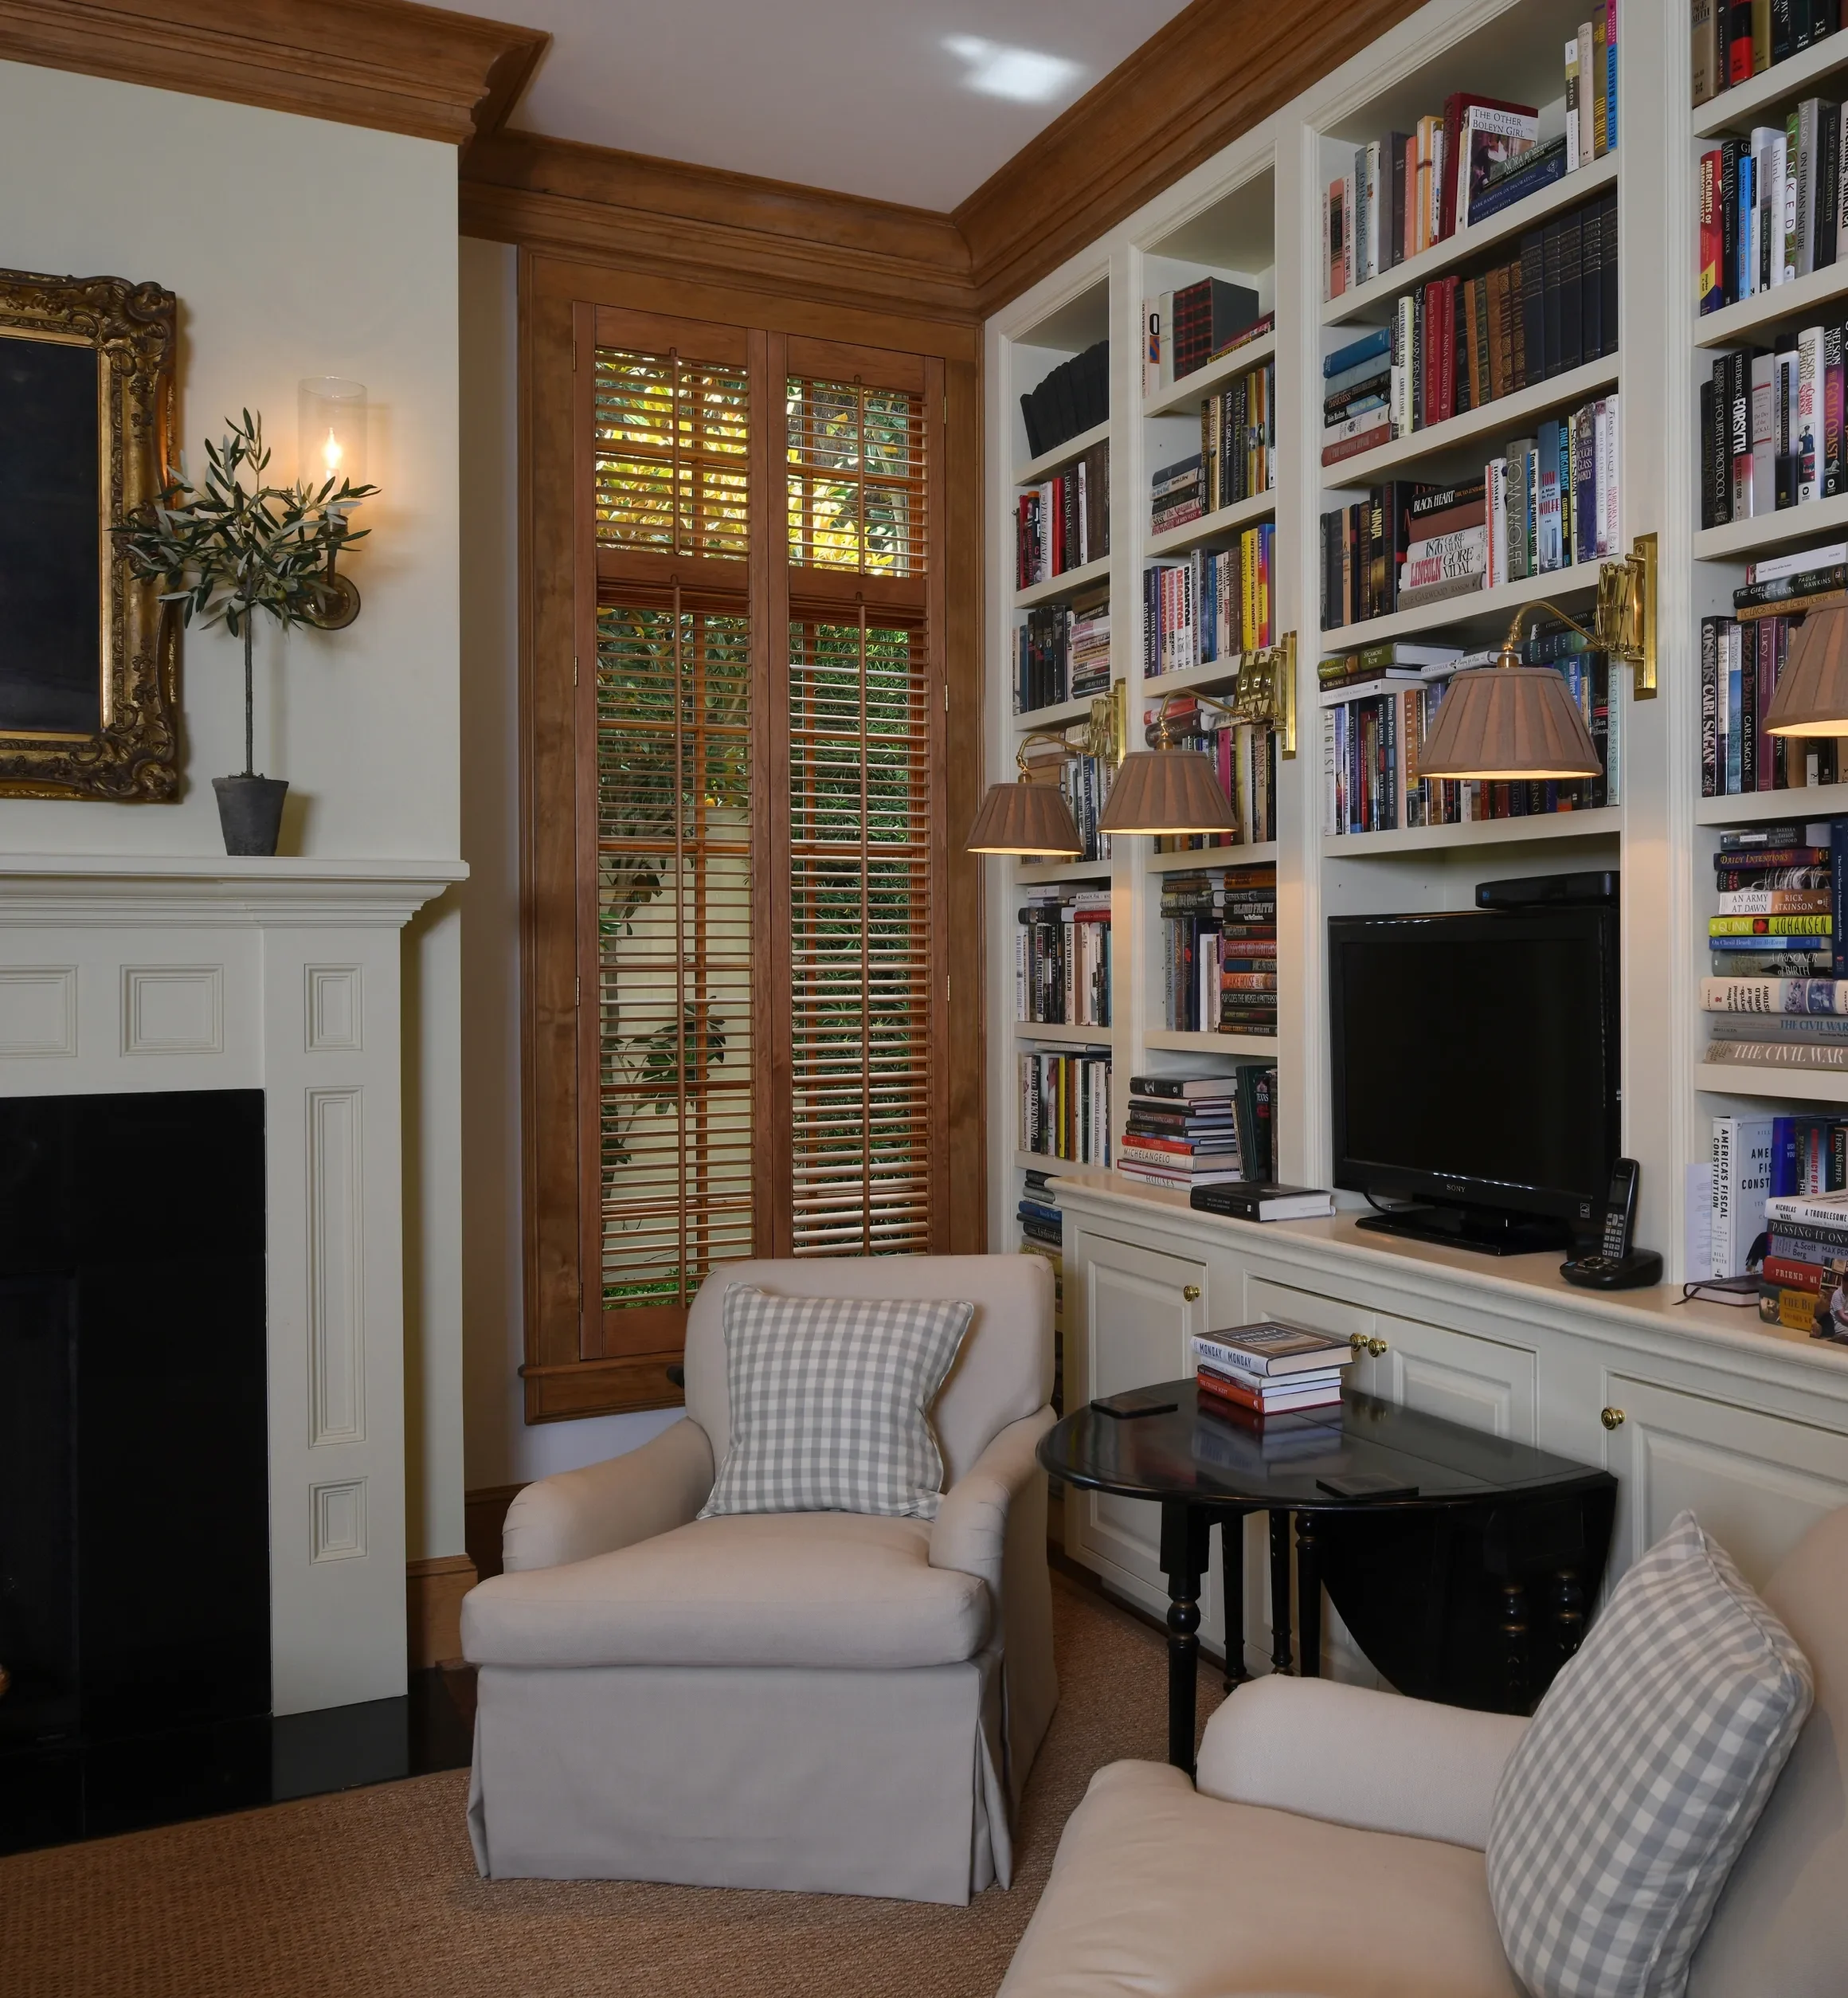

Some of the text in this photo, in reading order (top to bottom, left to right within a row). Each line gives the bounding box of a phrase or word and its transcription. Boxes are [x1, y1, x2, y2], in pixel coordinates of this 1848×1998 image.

[1609, 100, 1615, 113] MY
[1473, 108, 1522, 127] THE OTHER
[1473, 119, 1525, 138] BOLEYN GIRL
[1800, 151, 1807, 167] ON
[1723, 143, 1734, 202] METAMAN
[1799, 169, 1807, 210] HUMAN
[1705, 212, 1712, 224] OF
[1797, 211, 1806, 251] NATURE
[1345, 245, 1351, 255] OF
[1807, 339, 1815, 380] NELSON
[1760, 412, 1769, 421] Day
[1733, 398, 1746, 455] FORSYTH
[1715, 405, 1725, 503] FOURTH PROTOCOL
[1560, 450, 1568, 491] ARGUMENT
[1542, 472, 1556, 486] TOM
[1414, 490, 1455, 513] BLACK HEART
[1506, 453, 1522, 565] TOM WOLFE
[1539, 498, 1560, 516] WOLFE
[1371, 508, 1383, 539] NINJA
[1444, 532, 1465, 543] GORE
[1426, 539, 1443, 558] 1876
[1443, 547, 1474, 566] GORE
[1410, 555, 1442, 587] LINCOLN
[1443, 562, 1474, 578] VIDAL
[1798, 574, 1817, 583] PAULA
[1803, 578, 1830, 589] HAWKINS
[1415, 587, 1447, 603] GARWOOD
[1451, 583, 1470, 593] RANSOM
[1750, 586, 1765, 594] GIRL
[1772, 586, 1795, 597] TRAIN
[1364, 649, 1383, 659] SYCAMORE
[1702, 623, 1715, 764] COSMOS CARL SAGAN
[1325, 710, 1333, 776] AUGUST
[1719, 921, 1749, 932] QUINN
[1775, 915, 1826, 934] JOHANSEN
[1067, 949, 1072, 958] TO
[1777, 953, 1818, 962] PRISONER
[1785, 966, 1811, 975] BIRTH
[1239, 975, 1255, 988] HOUSE
[1780, 1020, 1848, 1031] THE CIVIL WAR
[1734, 1044, 1844, 1064] THE CIVIL WAR
[1124, 1148, 1170, 1164] MICHELANGELO
[1447, 1184, 1466, 1193] SONY
[1720, 1185, 1729, 1219] FISCAL
[1776, 1204, 1796, 1213] NICHOLAS
[1810, 1209, 1847, 1222] TROUBLESOME
[1772, 1221, 1844, 1244] PASSING IT ON
[1793, 1249, 1807, 1260] Berg
[1776, 1269, 1803, 1281] FRIEND
[1783, 1296, 1799, 1308] THE
[1231, 1329, 1278, 1339] MONDAY
[1200, 1343, 1251, 1367] MONDAY MONDAY
